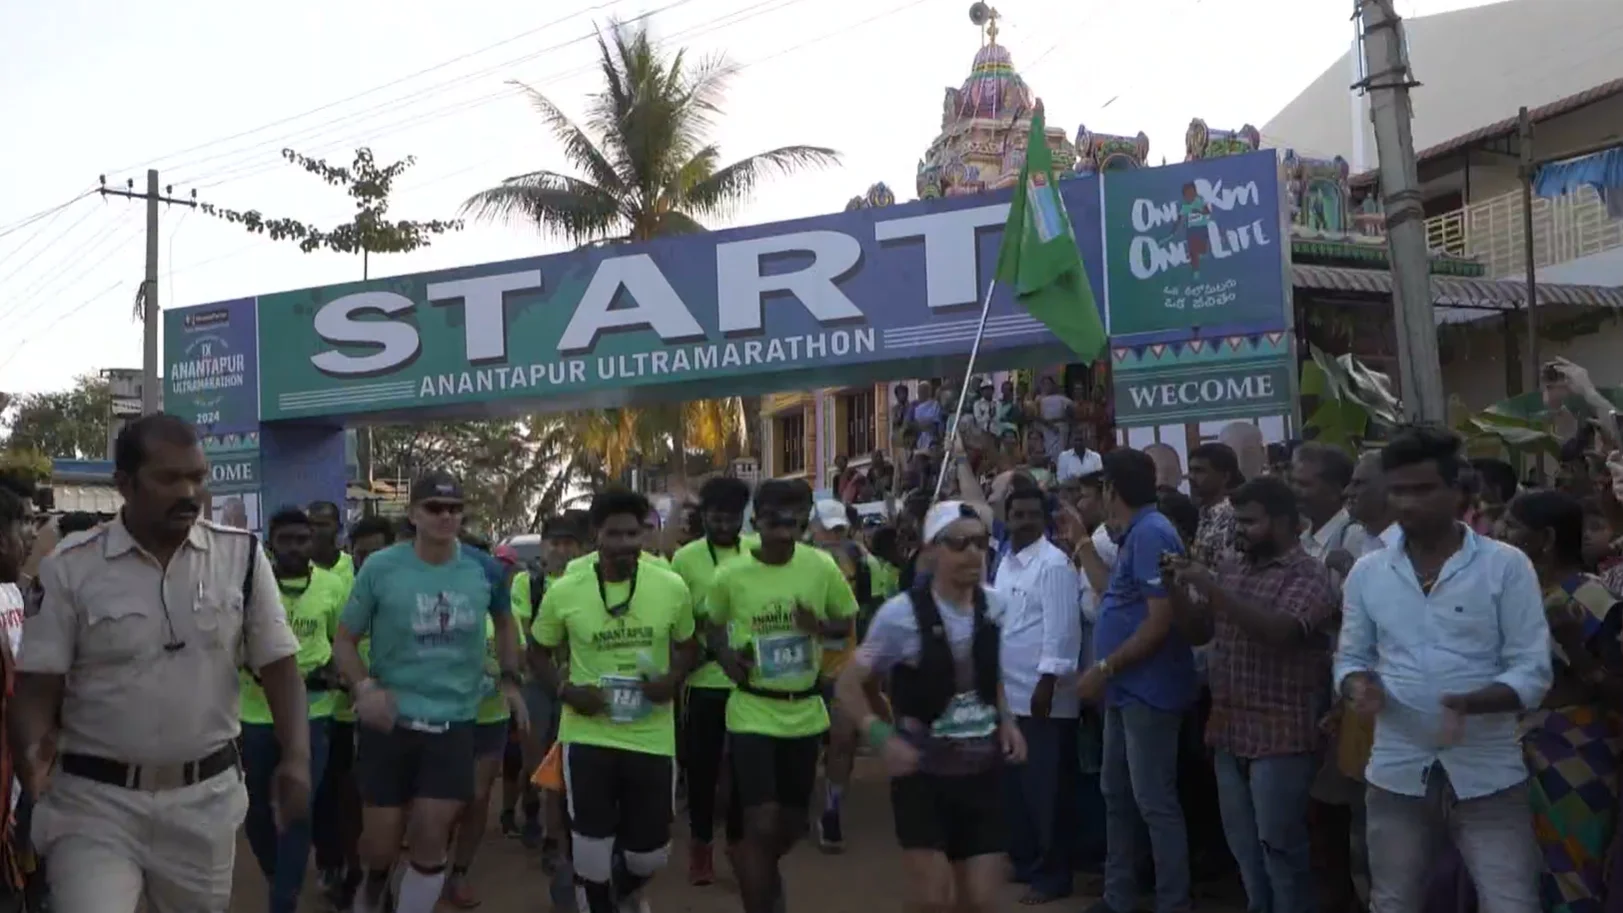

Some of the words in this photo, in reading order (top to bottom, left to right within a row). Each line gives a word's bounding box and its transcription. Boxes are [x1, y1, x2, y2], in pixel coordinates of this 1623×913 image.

[310, 202, 1012, 374] START
[202, 343, 213, 357] IX
[419, 360, 586, 398] ANANTAPUR
[597, 327, 876, 381] ULTRAMARATHON
[171, 354, 245, 381] ANANTAPUR
[1128, 374, 1275, 409] WECOME
[196, 411, 220, 425] 2024
